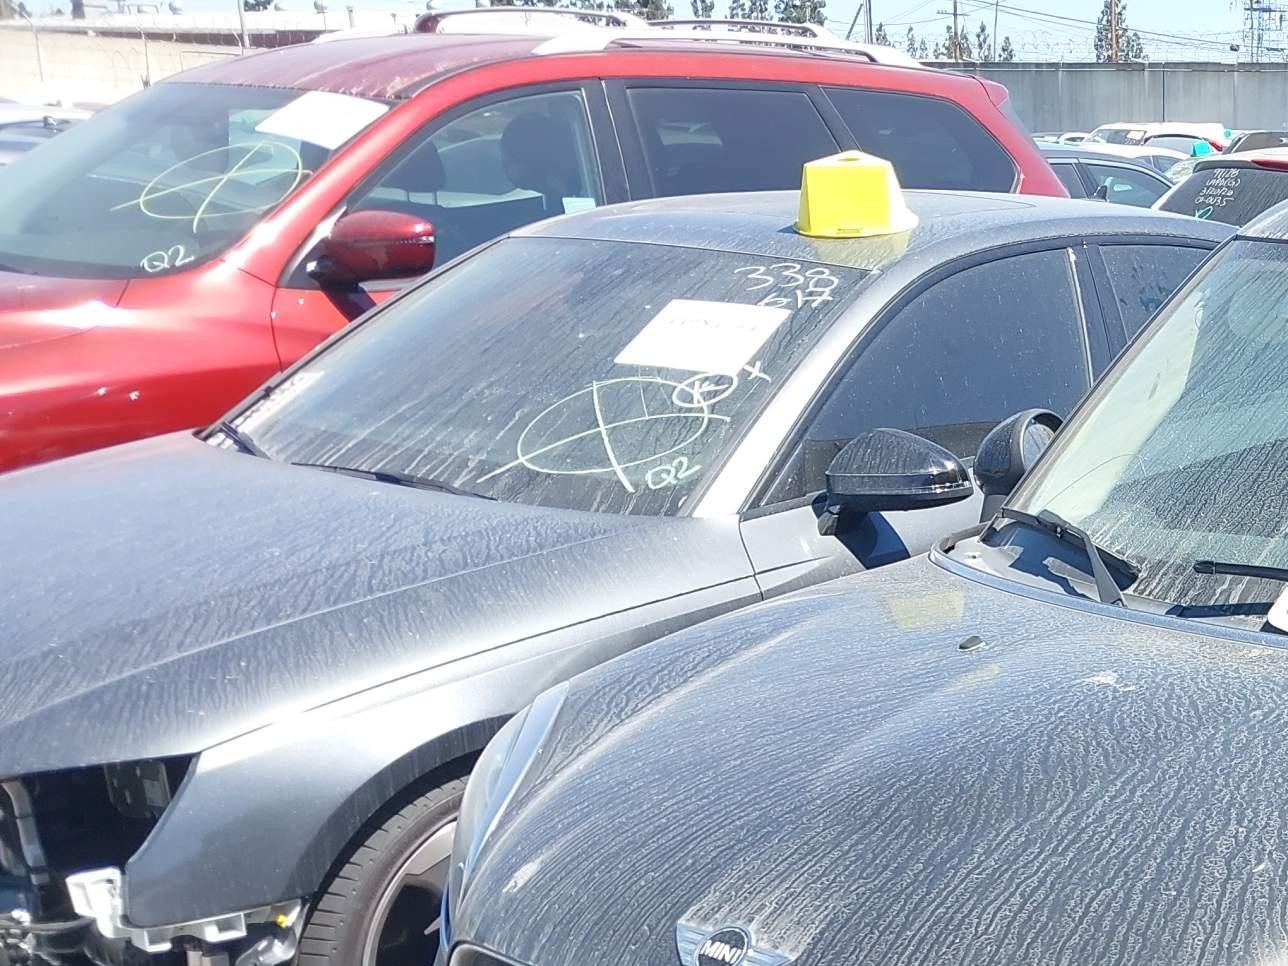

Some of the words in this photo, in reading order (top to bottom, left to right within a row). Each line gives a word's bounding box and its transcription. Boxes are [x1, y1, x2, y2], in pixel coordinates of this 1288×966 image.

[140, 244, 195, 272] Q2
[733, 262, 839, 293] 338
[645, 456, 702, 489] Q2
[700, 939, 743, 964] MINI
